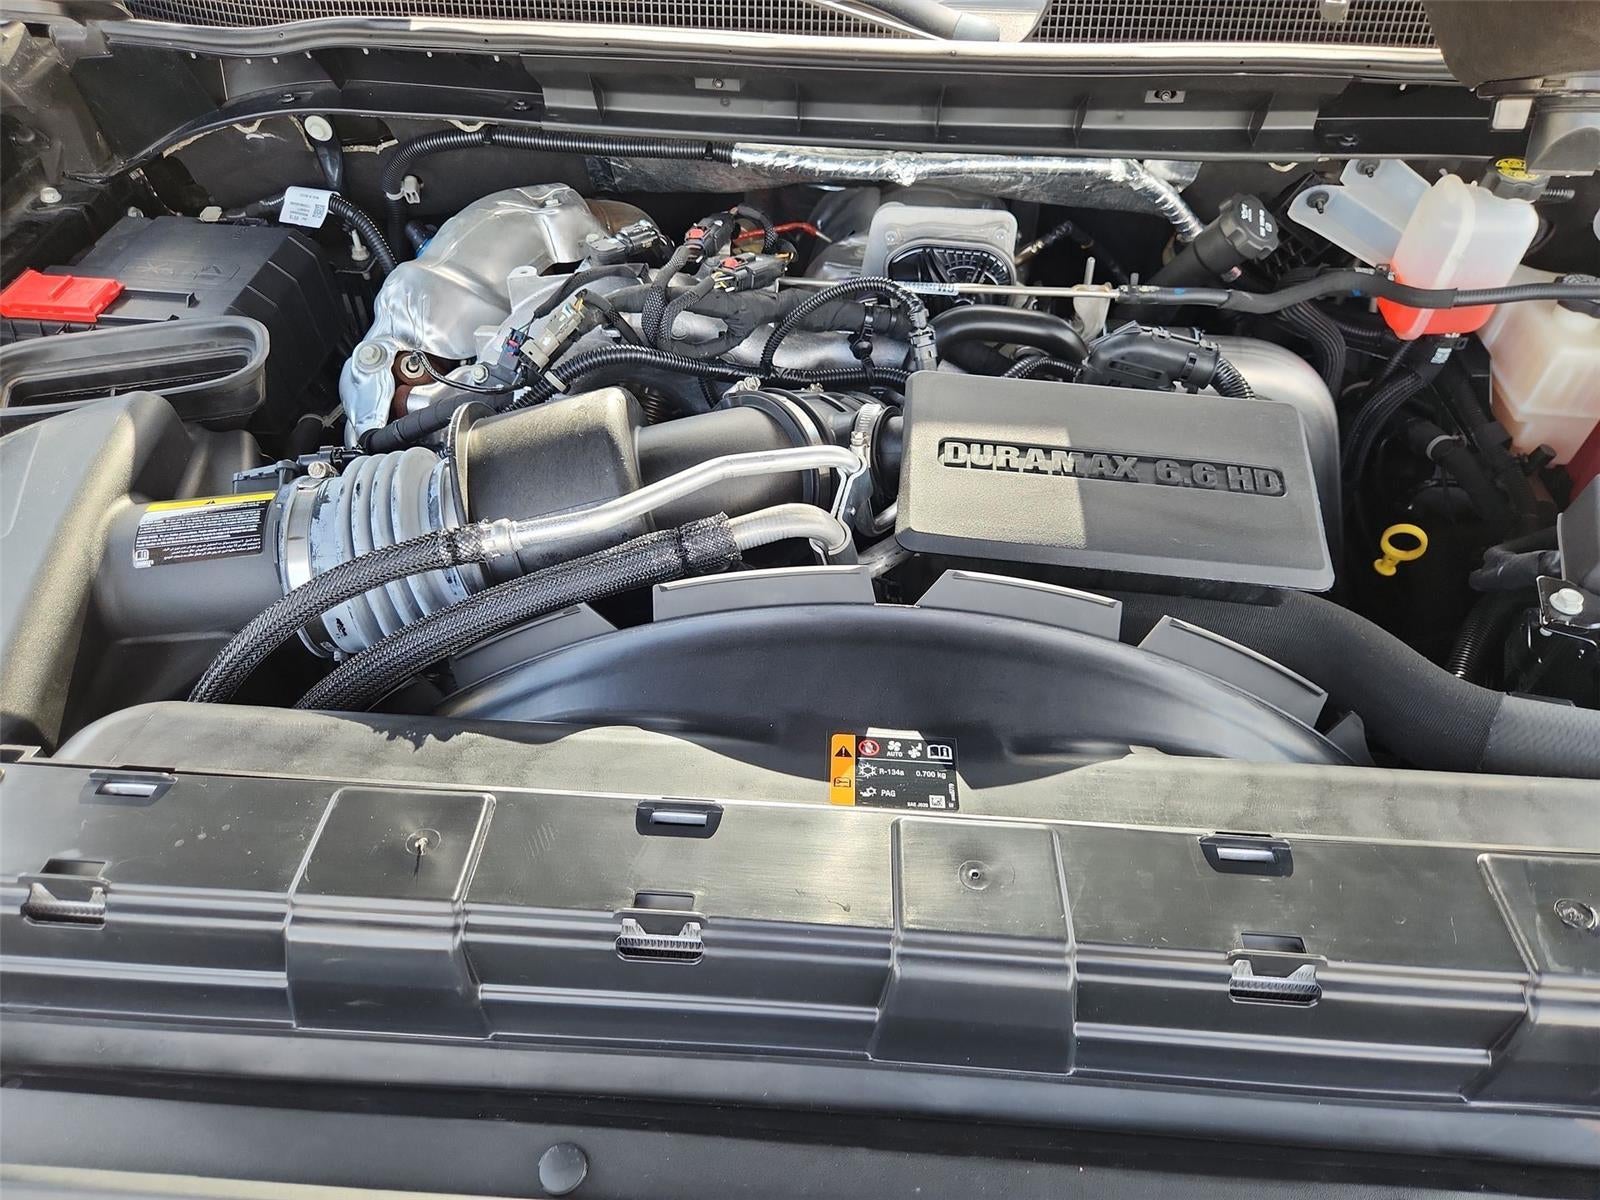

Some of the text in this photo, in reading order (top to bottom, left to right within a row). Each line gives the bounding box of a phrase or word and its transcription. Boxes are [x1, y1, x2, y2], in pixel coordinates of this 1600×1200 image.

[943, 441, 1284, 495] DURAMAX 6.6 HD
[879, 768, 947, 780] R-134a 0.700 kg
[881, 789, 896, 797] PAG
